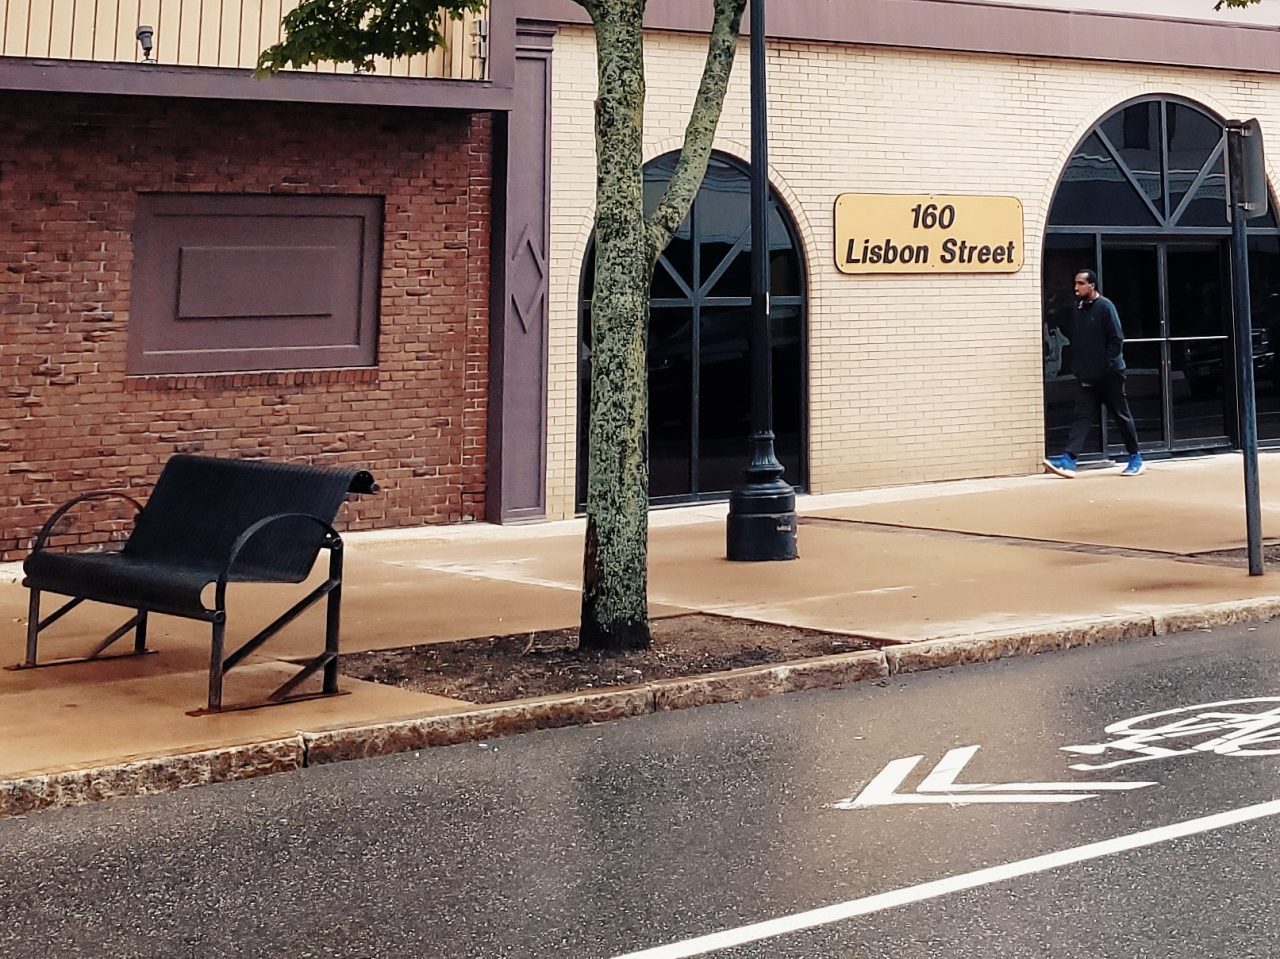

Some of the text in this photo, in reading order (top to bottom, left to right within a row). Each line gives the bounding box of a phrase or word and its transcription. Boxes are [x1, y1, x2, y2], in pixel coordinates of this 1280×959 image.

[911, 204, 956, 229] 160
[846, 238, 1015, 264] Lisbon Street
